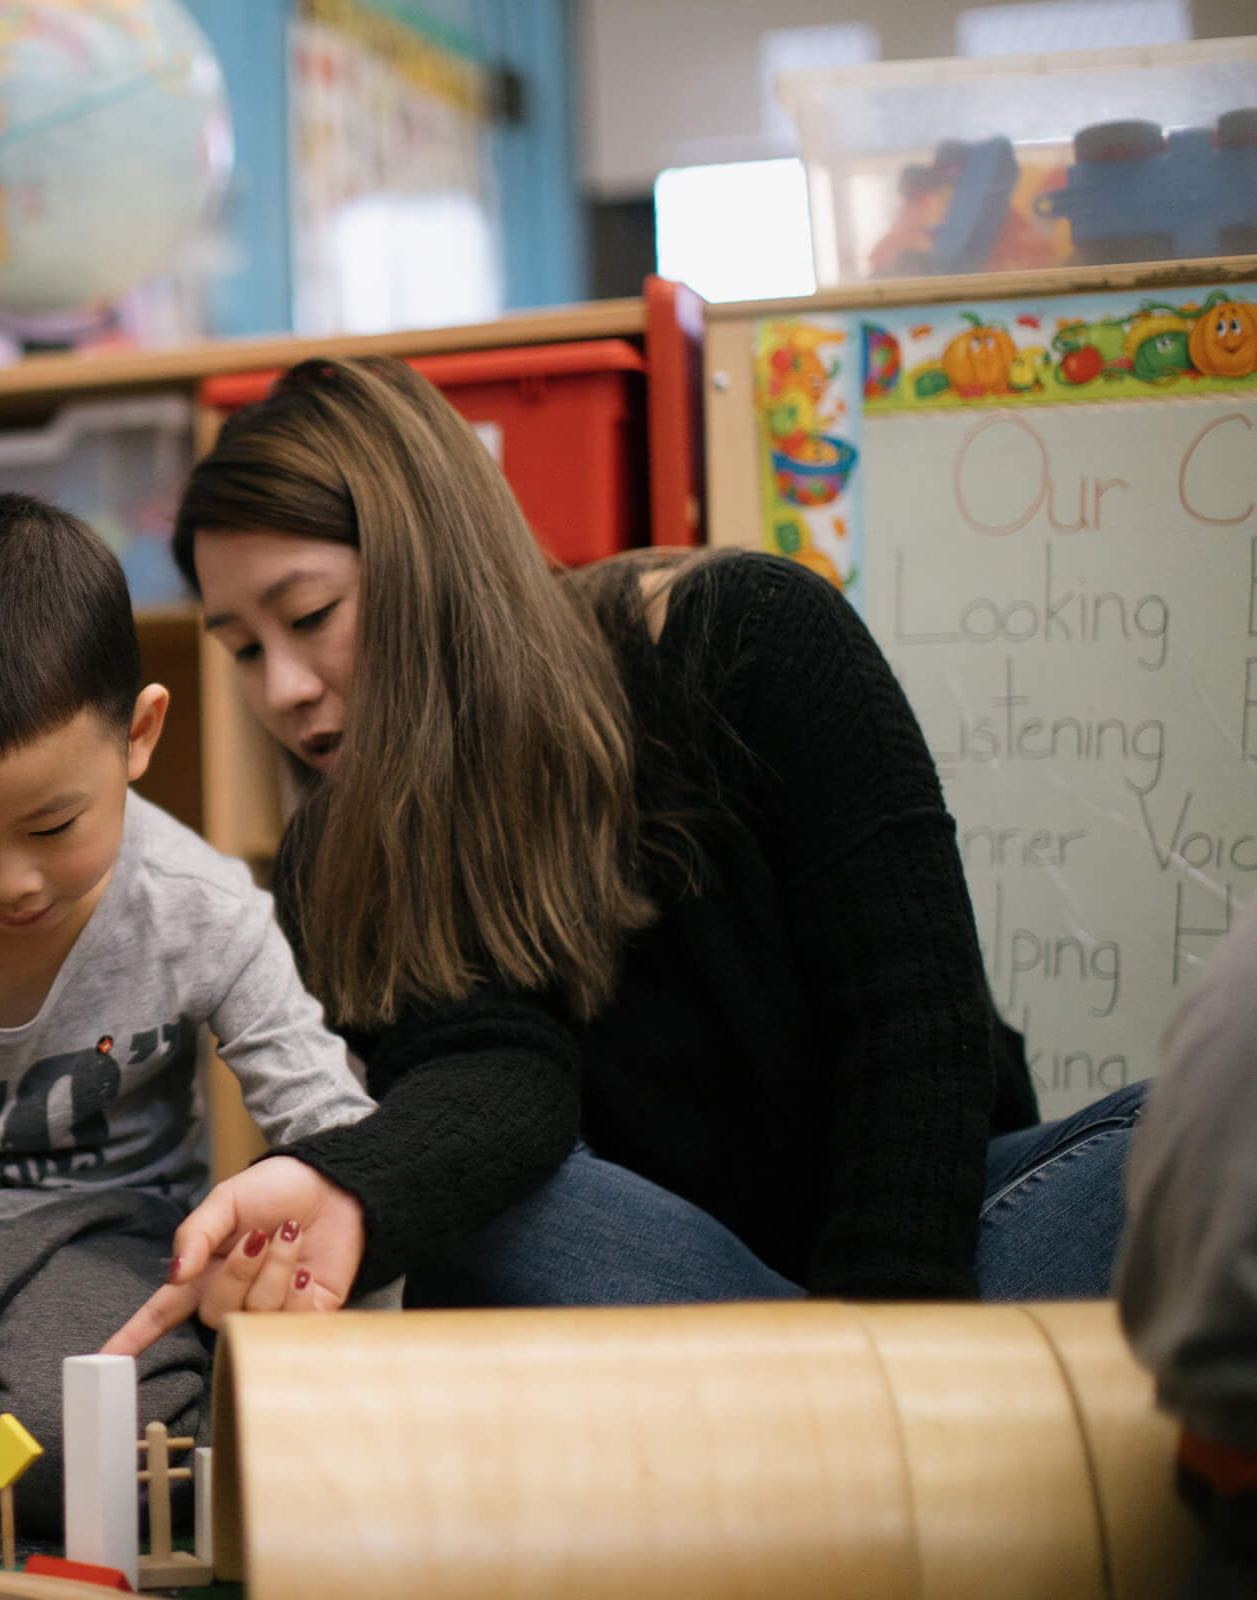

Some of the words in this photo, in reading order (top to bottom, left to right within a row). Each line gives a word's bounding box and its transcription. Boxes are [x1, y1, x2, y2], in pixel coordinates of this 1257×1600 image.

[954, 412, 1130, 537] Our
[895, 541, 1169, 672] Looking
[934, 655, 1166, 796] istening
[990, 878, 1121, 1019] lping
[1023, 1002, 1128, 1092] king
